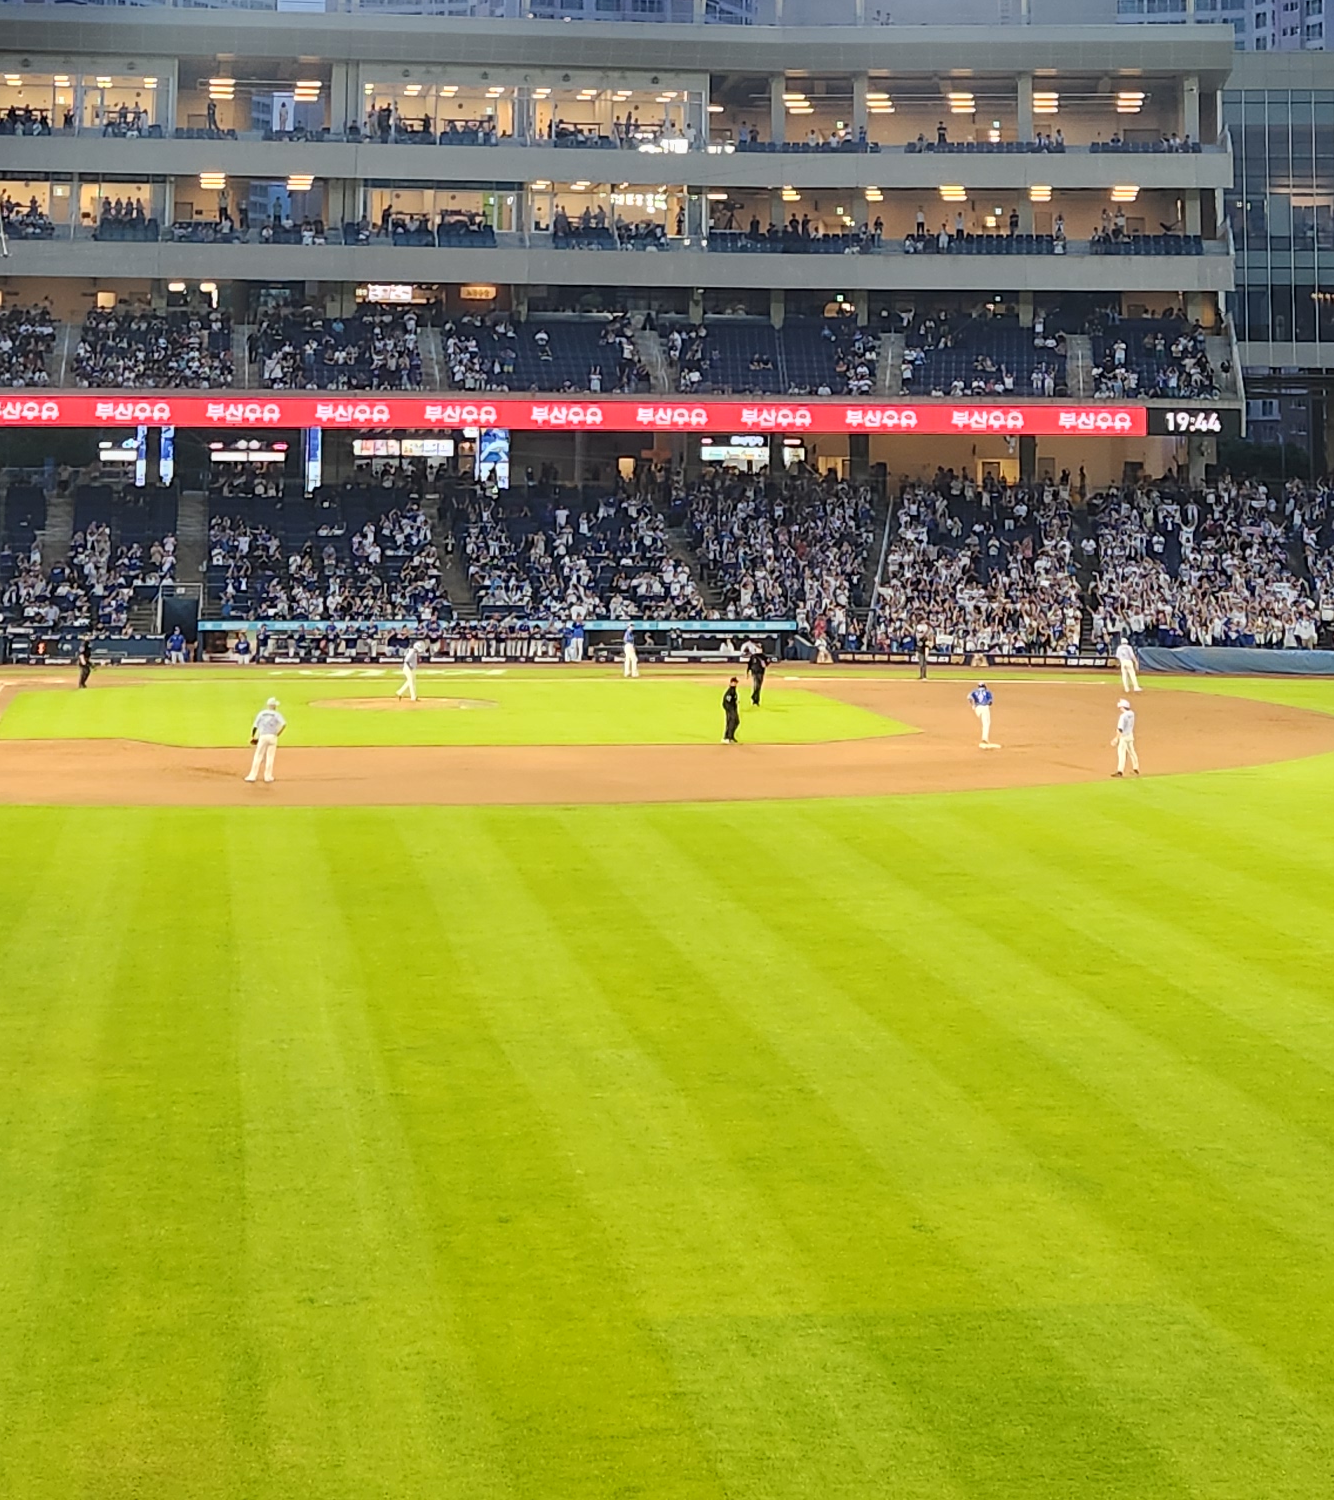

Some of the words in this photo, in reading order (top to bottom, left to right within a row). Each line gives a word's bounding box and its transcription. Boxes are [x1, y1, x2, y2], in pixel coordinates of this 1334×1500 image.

[96, 402, 171, 421] 부산우유
[206, 403, 280, 422] 부산우유
[316, 403, 390, 423] 부산우유
[424, 404, 498, 424] 부산우유
[531, 405, 602, 425] 부산우유
[637, 406, 708, 426] 부산우유
[741, 408, 812, 427] 부산우유
[845, 409, 917, 428] 부산우유
[951, 411, 1024, 429] 부산우유
[1058, 412, 1132, 430] 부산우유
[1165, 412, 1222, 433] 19:44
